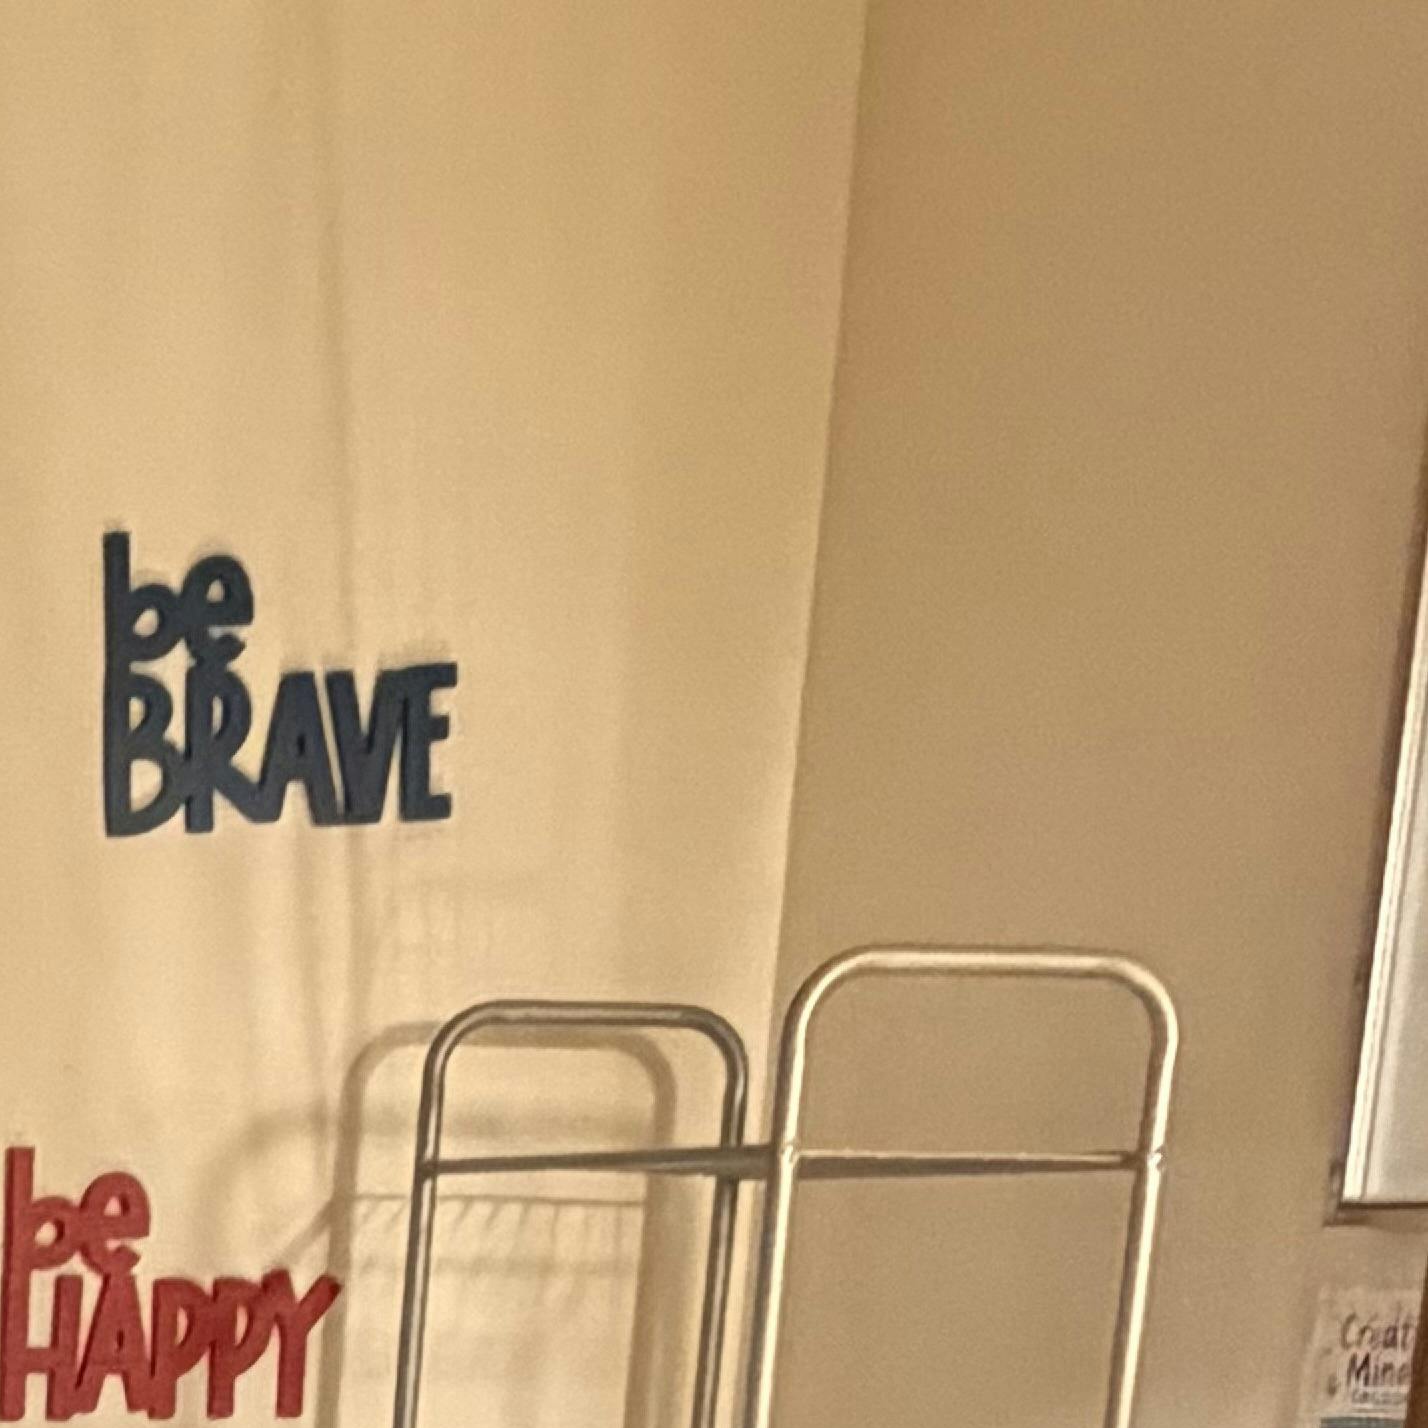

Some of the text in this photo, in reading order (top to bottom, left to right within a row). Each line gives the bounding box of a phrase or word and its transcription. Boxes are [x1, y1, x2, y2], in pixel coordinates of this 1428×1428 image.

[102, 530, 255, 665] be
[103, 661, 458, 838] BRAVE
[1, 1146, 152, 1274] be
